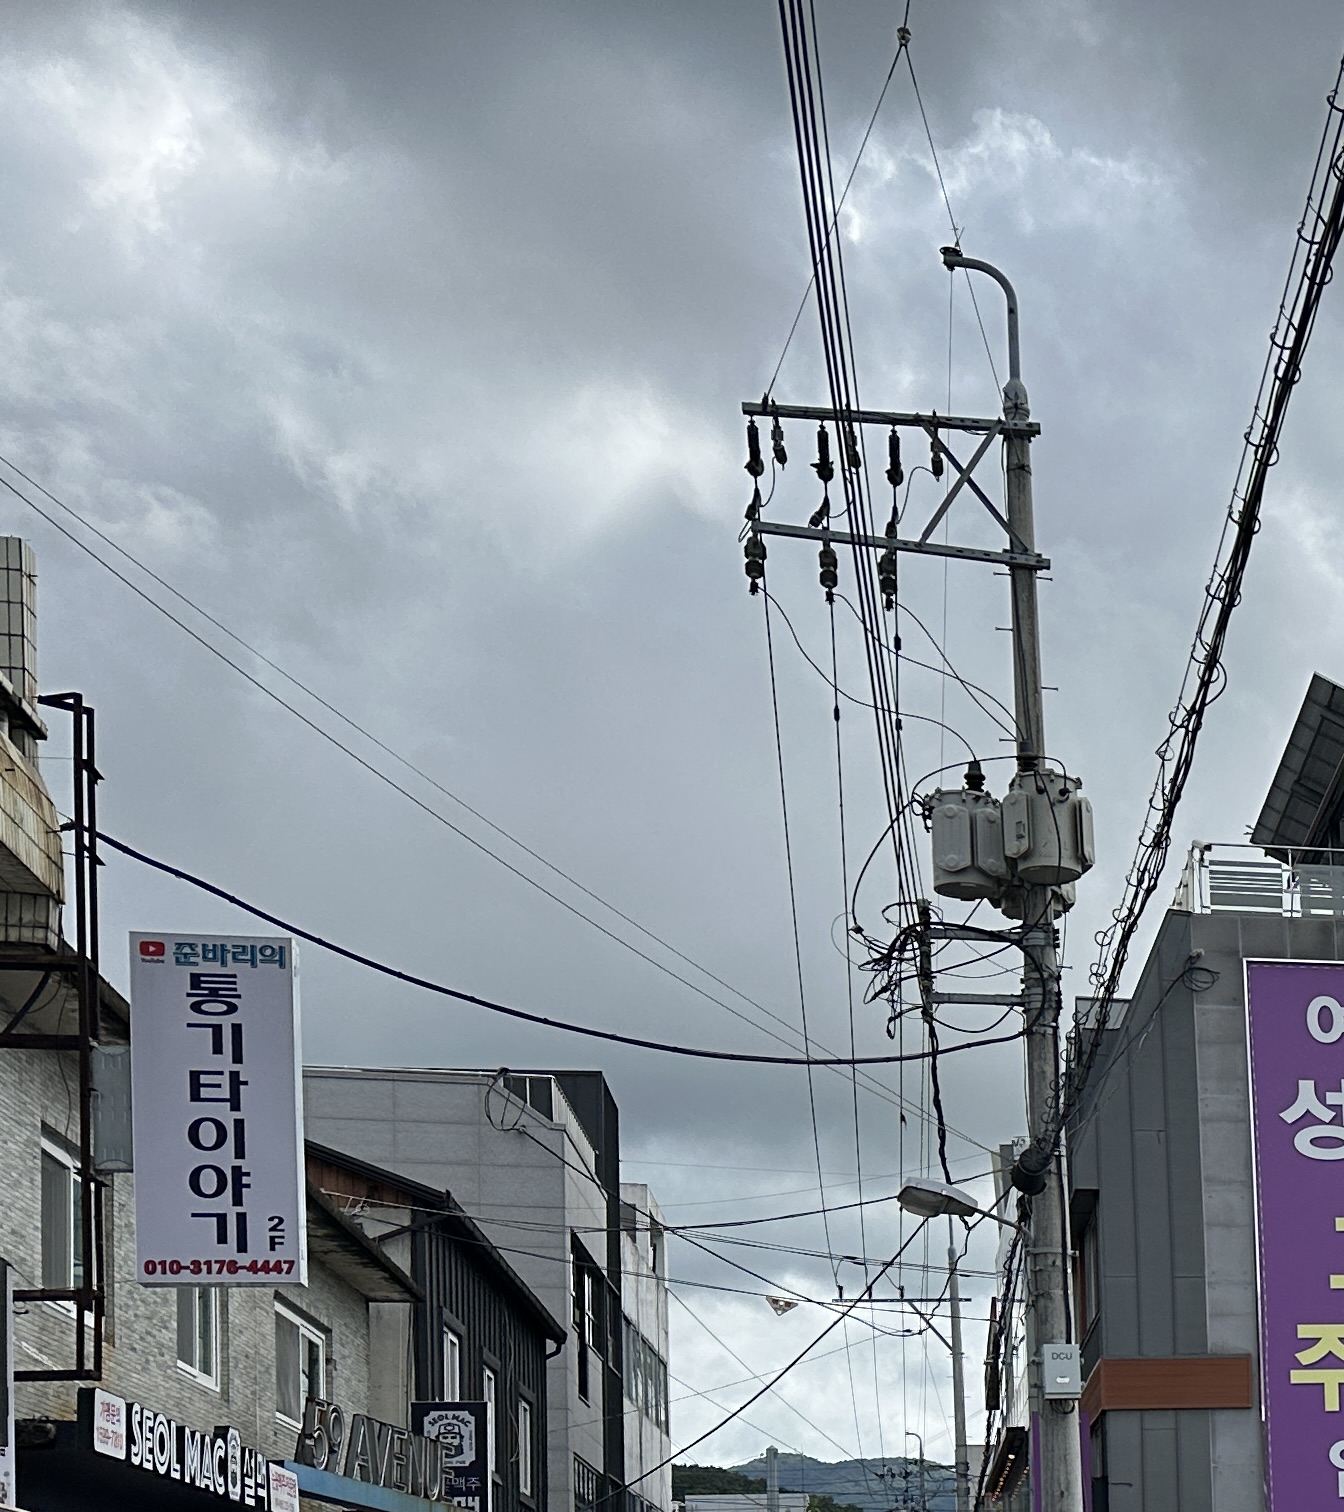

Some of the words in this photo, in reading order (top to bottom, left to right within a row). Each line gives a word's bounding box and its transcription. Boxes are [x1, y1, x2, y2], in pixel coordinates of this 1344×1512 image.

[172, 942, 286, 969] 준바리의
[144, 1259, 295, 1275] 010-3176-4447
[1051, 1352, 1073, 1360] DCU
[428, 1413, 450, 1427] SEOL
[451, 1412, 471, 1428] MAC
[131, 1402, 181, 1480] SEOL
[185, 1426, 226, 1495] MAC
[305, 1398, 345, 1475] 59
[352, 1416, 455, 1504] AVENUE
[452, 1476, 482, 1491] 맥주
